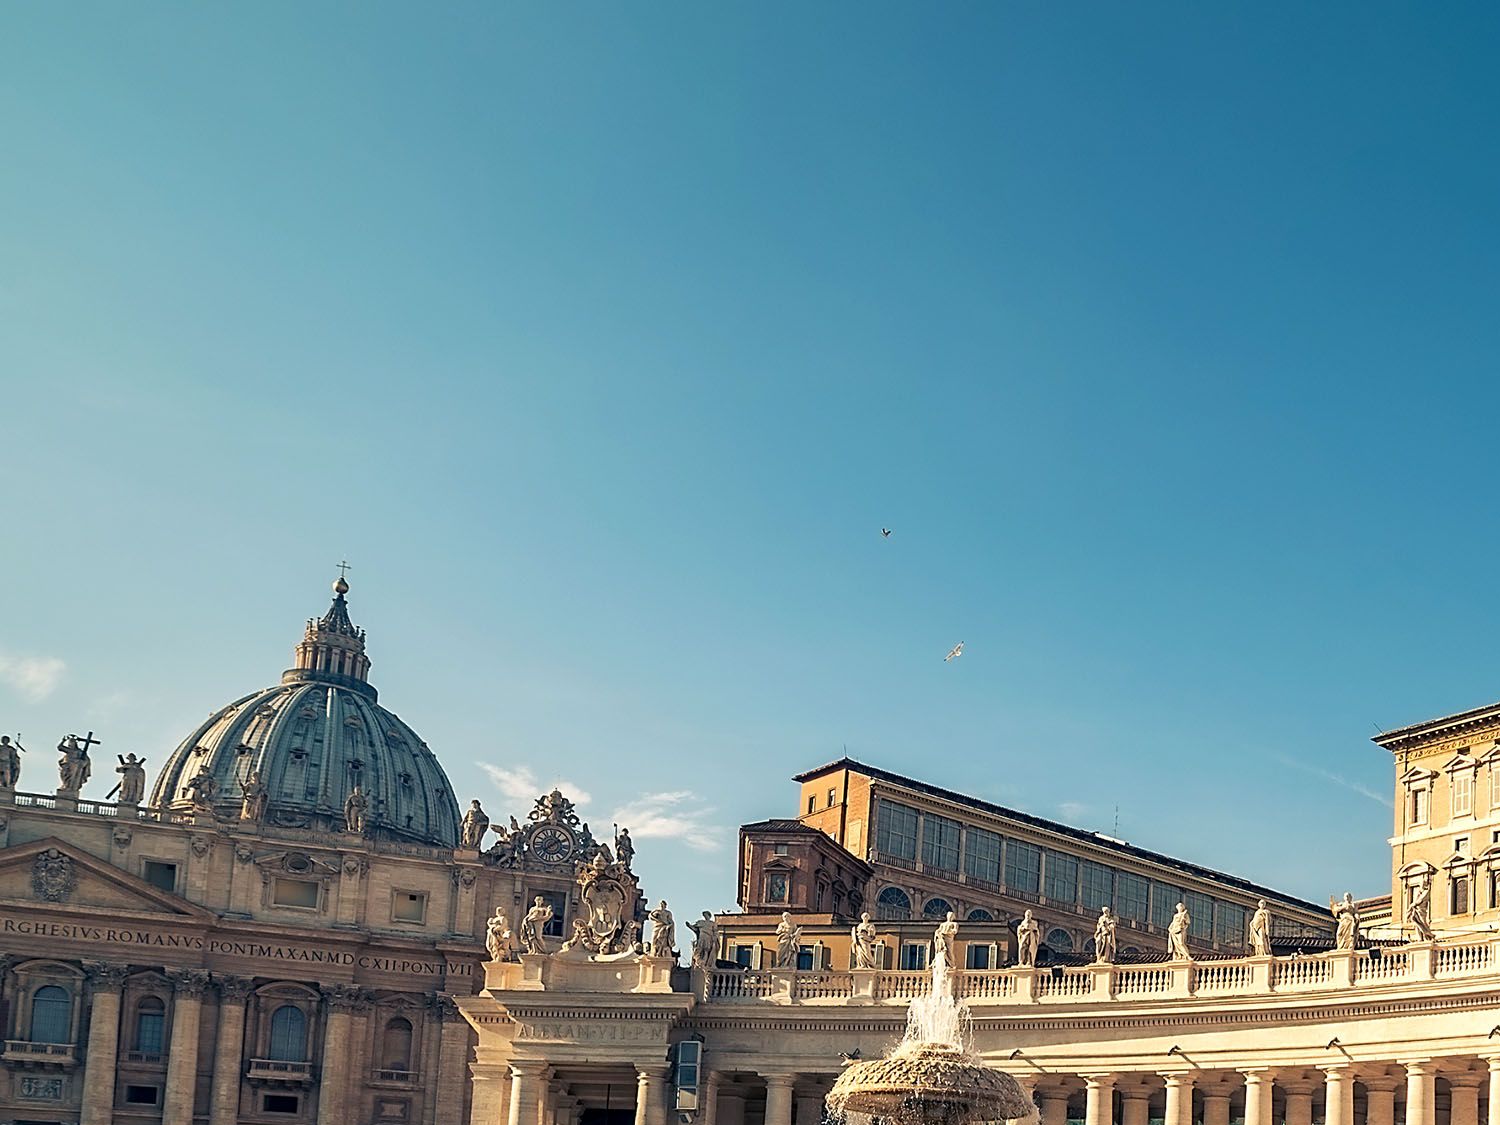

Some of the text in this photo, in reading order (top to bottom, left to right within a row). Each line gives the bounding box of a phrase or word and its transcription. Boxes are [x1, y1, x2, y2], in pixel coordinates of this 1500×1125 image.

[106, 929, 203, 949] ROMANVS
[209, 940, 258, 955] PONT
[257, 945, 296, 960] MAX
[299, 950, 324, 962] AN
[449, 963, 472, 976] VII
[599, 1024, 626, 1040] VII
[650, 1026, 665, 1041] M
